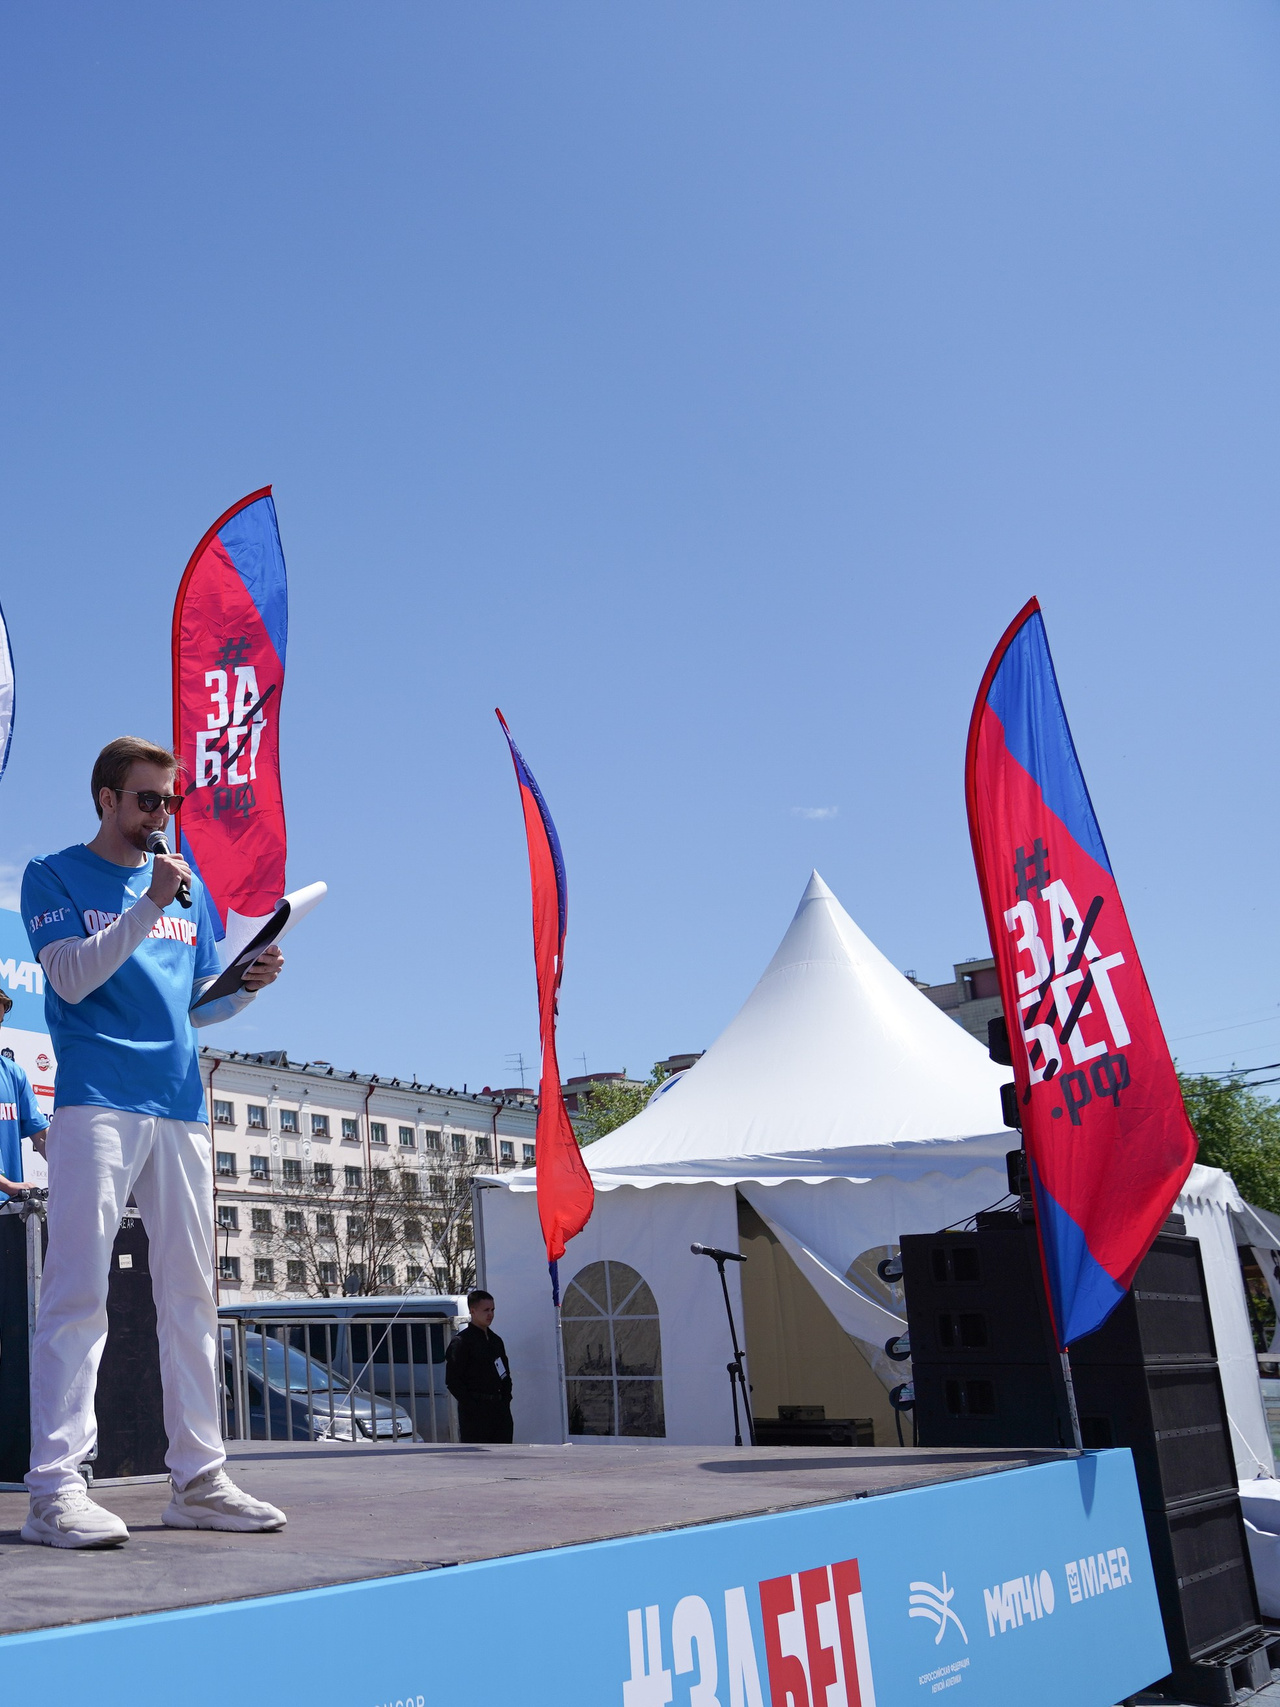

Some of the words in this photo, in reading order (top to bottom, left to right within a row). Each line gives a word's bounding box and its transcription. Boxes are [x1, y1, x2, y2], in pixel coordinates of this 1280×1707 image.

[204, 665, 264, 730] ЗА
[1003, 878, 1102, 994] ЗА
[1016, 951, 1132, 1087] БЕГ
[1079, 1546, 1132, 1599] MAER
